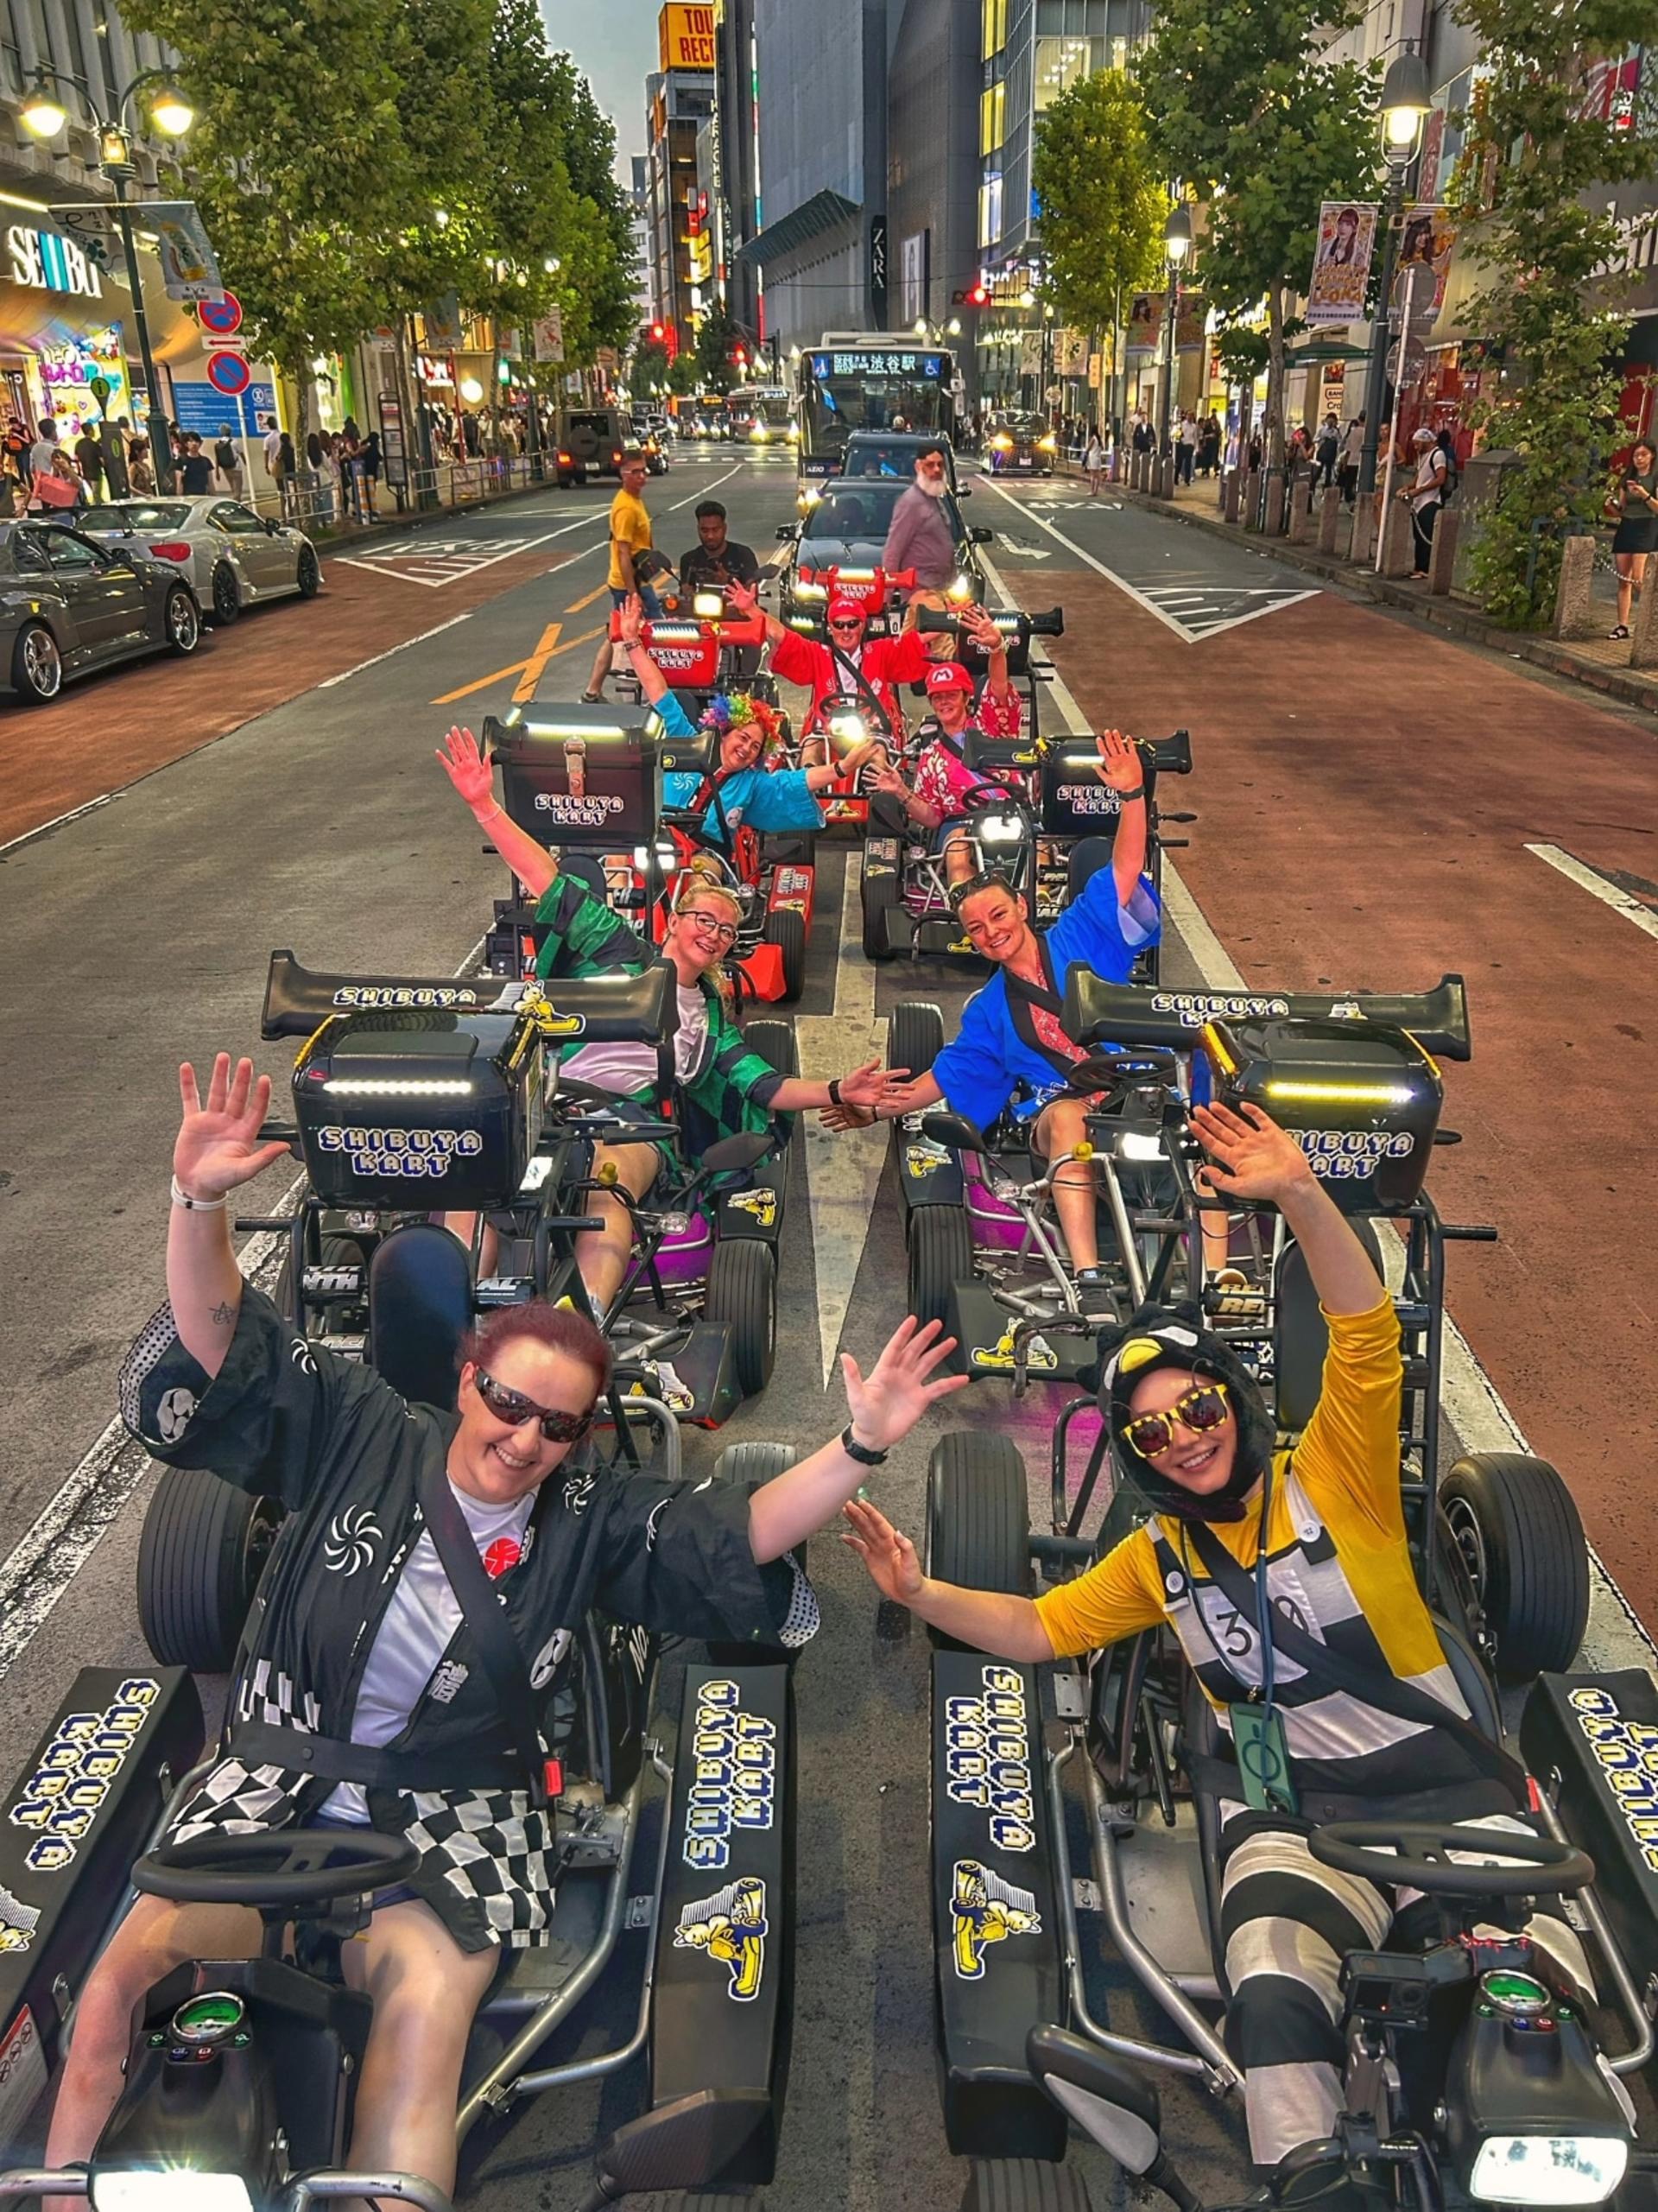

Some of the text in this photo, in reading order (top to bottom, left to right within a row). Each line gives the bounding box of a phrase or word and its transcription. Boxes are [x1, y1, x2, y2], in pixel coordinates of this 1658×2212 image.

[8, 225, 103, 298] SEIBU
[872, 228, 885, 288] ZARA
[870, 354, 915, 371] 渋谷駅
[647, 647, 705, 662] SHIBUYA
[535, 794, 623, 814] SHIBUYA
[1057, 785, 1123, 802] SHIBU
[1072, 798, 1122, 814] KART
[553, 809, 608, 827] KART
[333, 986, 477, 1008] SHIBUYA
[1152, 994, 1290, 1016] SHIBUYA
[319, 1126, 483, 1156] SHIBUYA
[1285, 1129, 1414, 1157] IBUYA
[352, 1151, 452, 1177] KART
[1309, 1154, 1381, 1179] ART
[1216, 1610, 1251, 1657] 3
[946, 1695, 990, 1808] KART
[982, 1665, 1036, 1852] SHIBUYA
[9, 1713, 102, 1829] KART
[24, 1678, 161, 1871] SHIBUYA
[682, 1679, 740, 1870] SHIBUYA
[731, 1712, 775, 1829] KART
